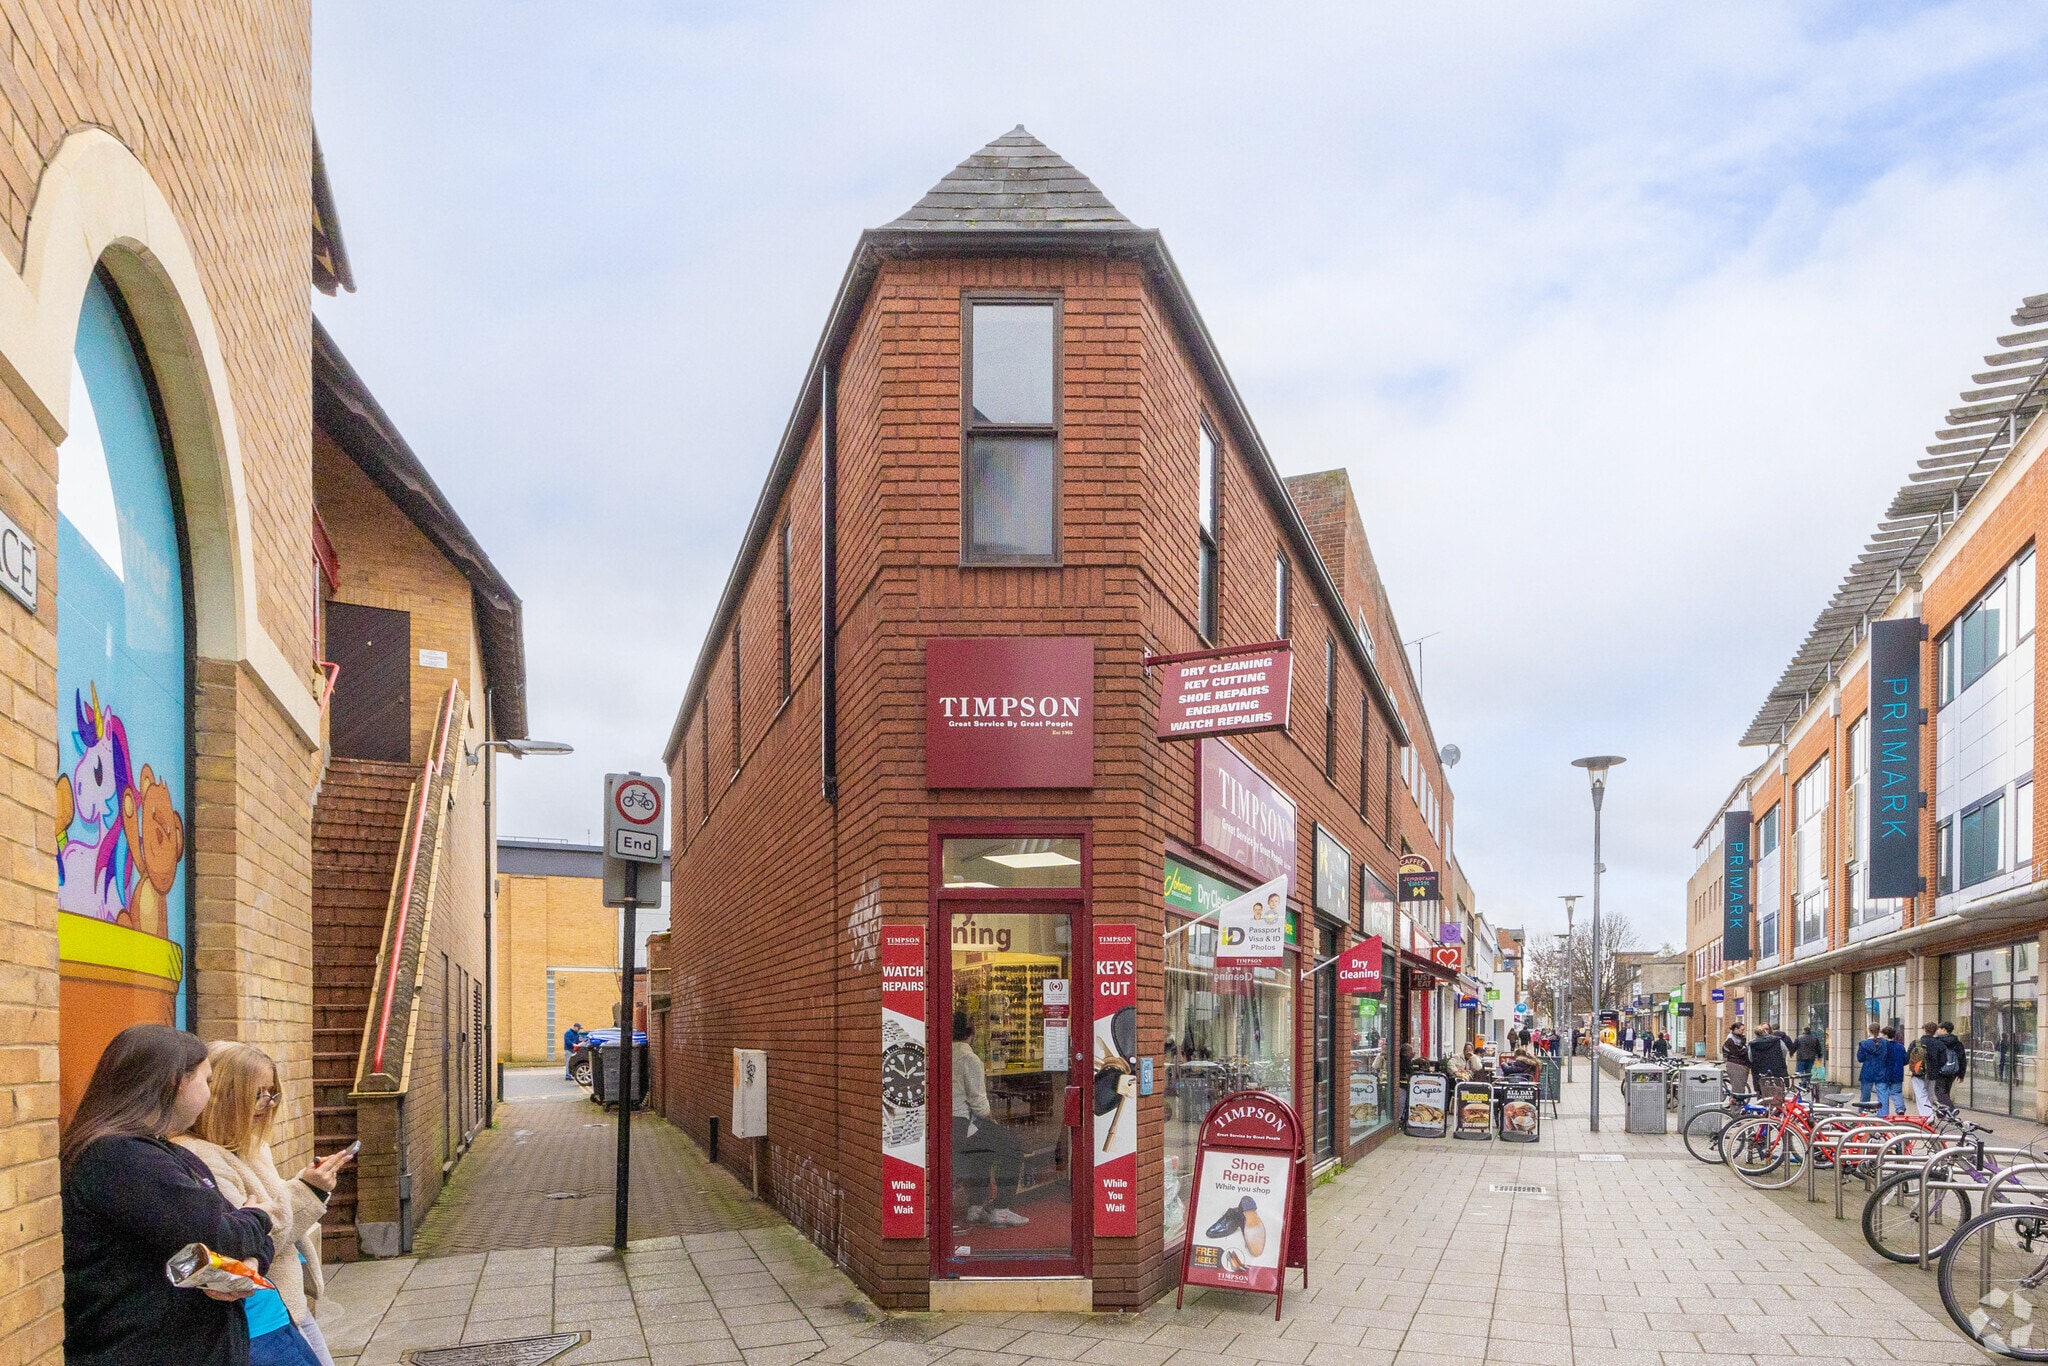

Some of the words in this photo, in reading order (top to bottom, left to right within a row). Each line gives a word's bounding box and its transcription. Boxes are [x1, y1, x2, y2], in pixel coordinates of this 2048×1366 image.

[0, 528, 33, 597] CE
[1180, 666, 1206, 677] DRY
[1209, 658, 1273, 674] CLEANING
[1184, 679, 1209, 690] KEY
[1212, 672, 1266, 687] CUTTING
[1178, 692, 1211, 704] SHOE
[1215, 685, 1269, 700] REPAIRS
[939, 697, 1081, 717] TIMPSON
[1186, 700, 1259, 716] ENGRAVING
[1045, 721, 1073, 729] People
[1170, 719, 1213, 731] WATCH
[1217, 712, 1273, 726] REPAIRS
[1881, 677, 1908, 839] PRIMARK
[1219, 768, 1286, 850] TIMPSON
[1222, 818, 1235, 836] Great
[1237, 827, 1253, 846] Service
[624, 836, 652, 851] End
[1400, 858, 1425, 866] CAFFEE
[1729, 841, 1744, 929] PRIMARK
[1198, 884, 1210, 909] Dry
[952, 921, 1011, 952] ning
[1249, 926, 1281, 934] Passport
[1096, 961, 1133, 975] KEYS
[1352, 959, 1368, 970] Dry
[882, 966, 923, 977] WATCH
[1339, 969, 1380, 980] Cleaning
[882, 982, 924, 991] REPAIRS
[1100, 981, 1130, 996] CUT
[1413, 1086, 1442, 1097] Crepes
[1215, 1106, 1286, 1132] TIMPSON
[1231, 1158, 1264, 1171] Shoe
[1223, 1169, 1270, 1184] Repairs
[891, 1181, 916, 1190] While
[1103, 1179, 1128, 1188] While
[1216, 1183, 1236, 1191] While
[1253, 1187, 1271, 1195] shop
[896, 1193, 911, 1202] You
[1108, 1191, 1123, 1200] You
[893, 1205, 914, 1214] Wait
[1105, 1203, 1126, 1212] Wait
[1195, 1247, 1218, 1256] FREE
[1195, 1256, 1217, 1264] HEELS
[1218, 1273, 1249, 1281] TIMPSON
